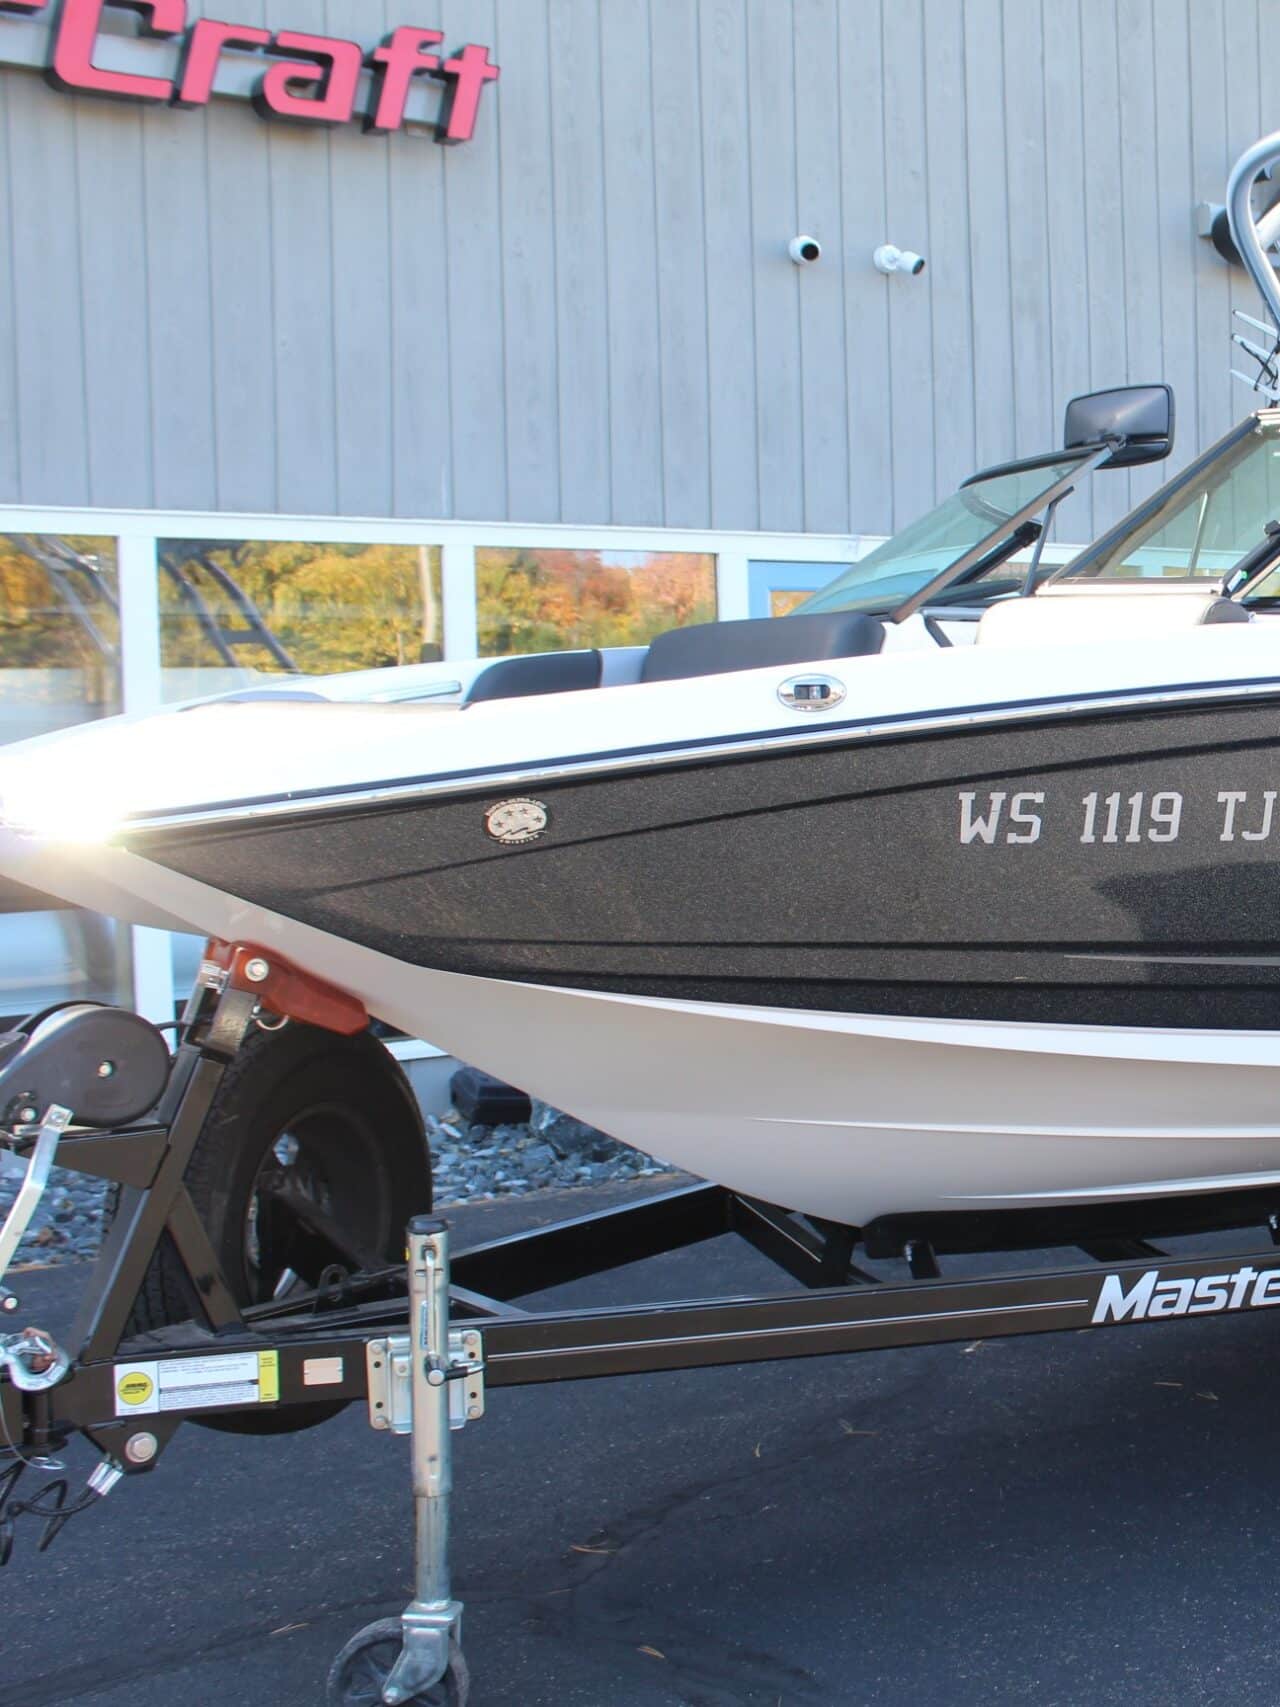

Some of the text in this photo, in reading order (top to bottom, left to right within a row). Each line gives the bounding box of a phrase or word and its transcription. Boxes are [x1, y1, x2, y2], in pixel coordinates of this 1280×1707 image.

[0, 0, 500, 145] Craft
[958, 791, 1277, 844] WS 1119 TJ
